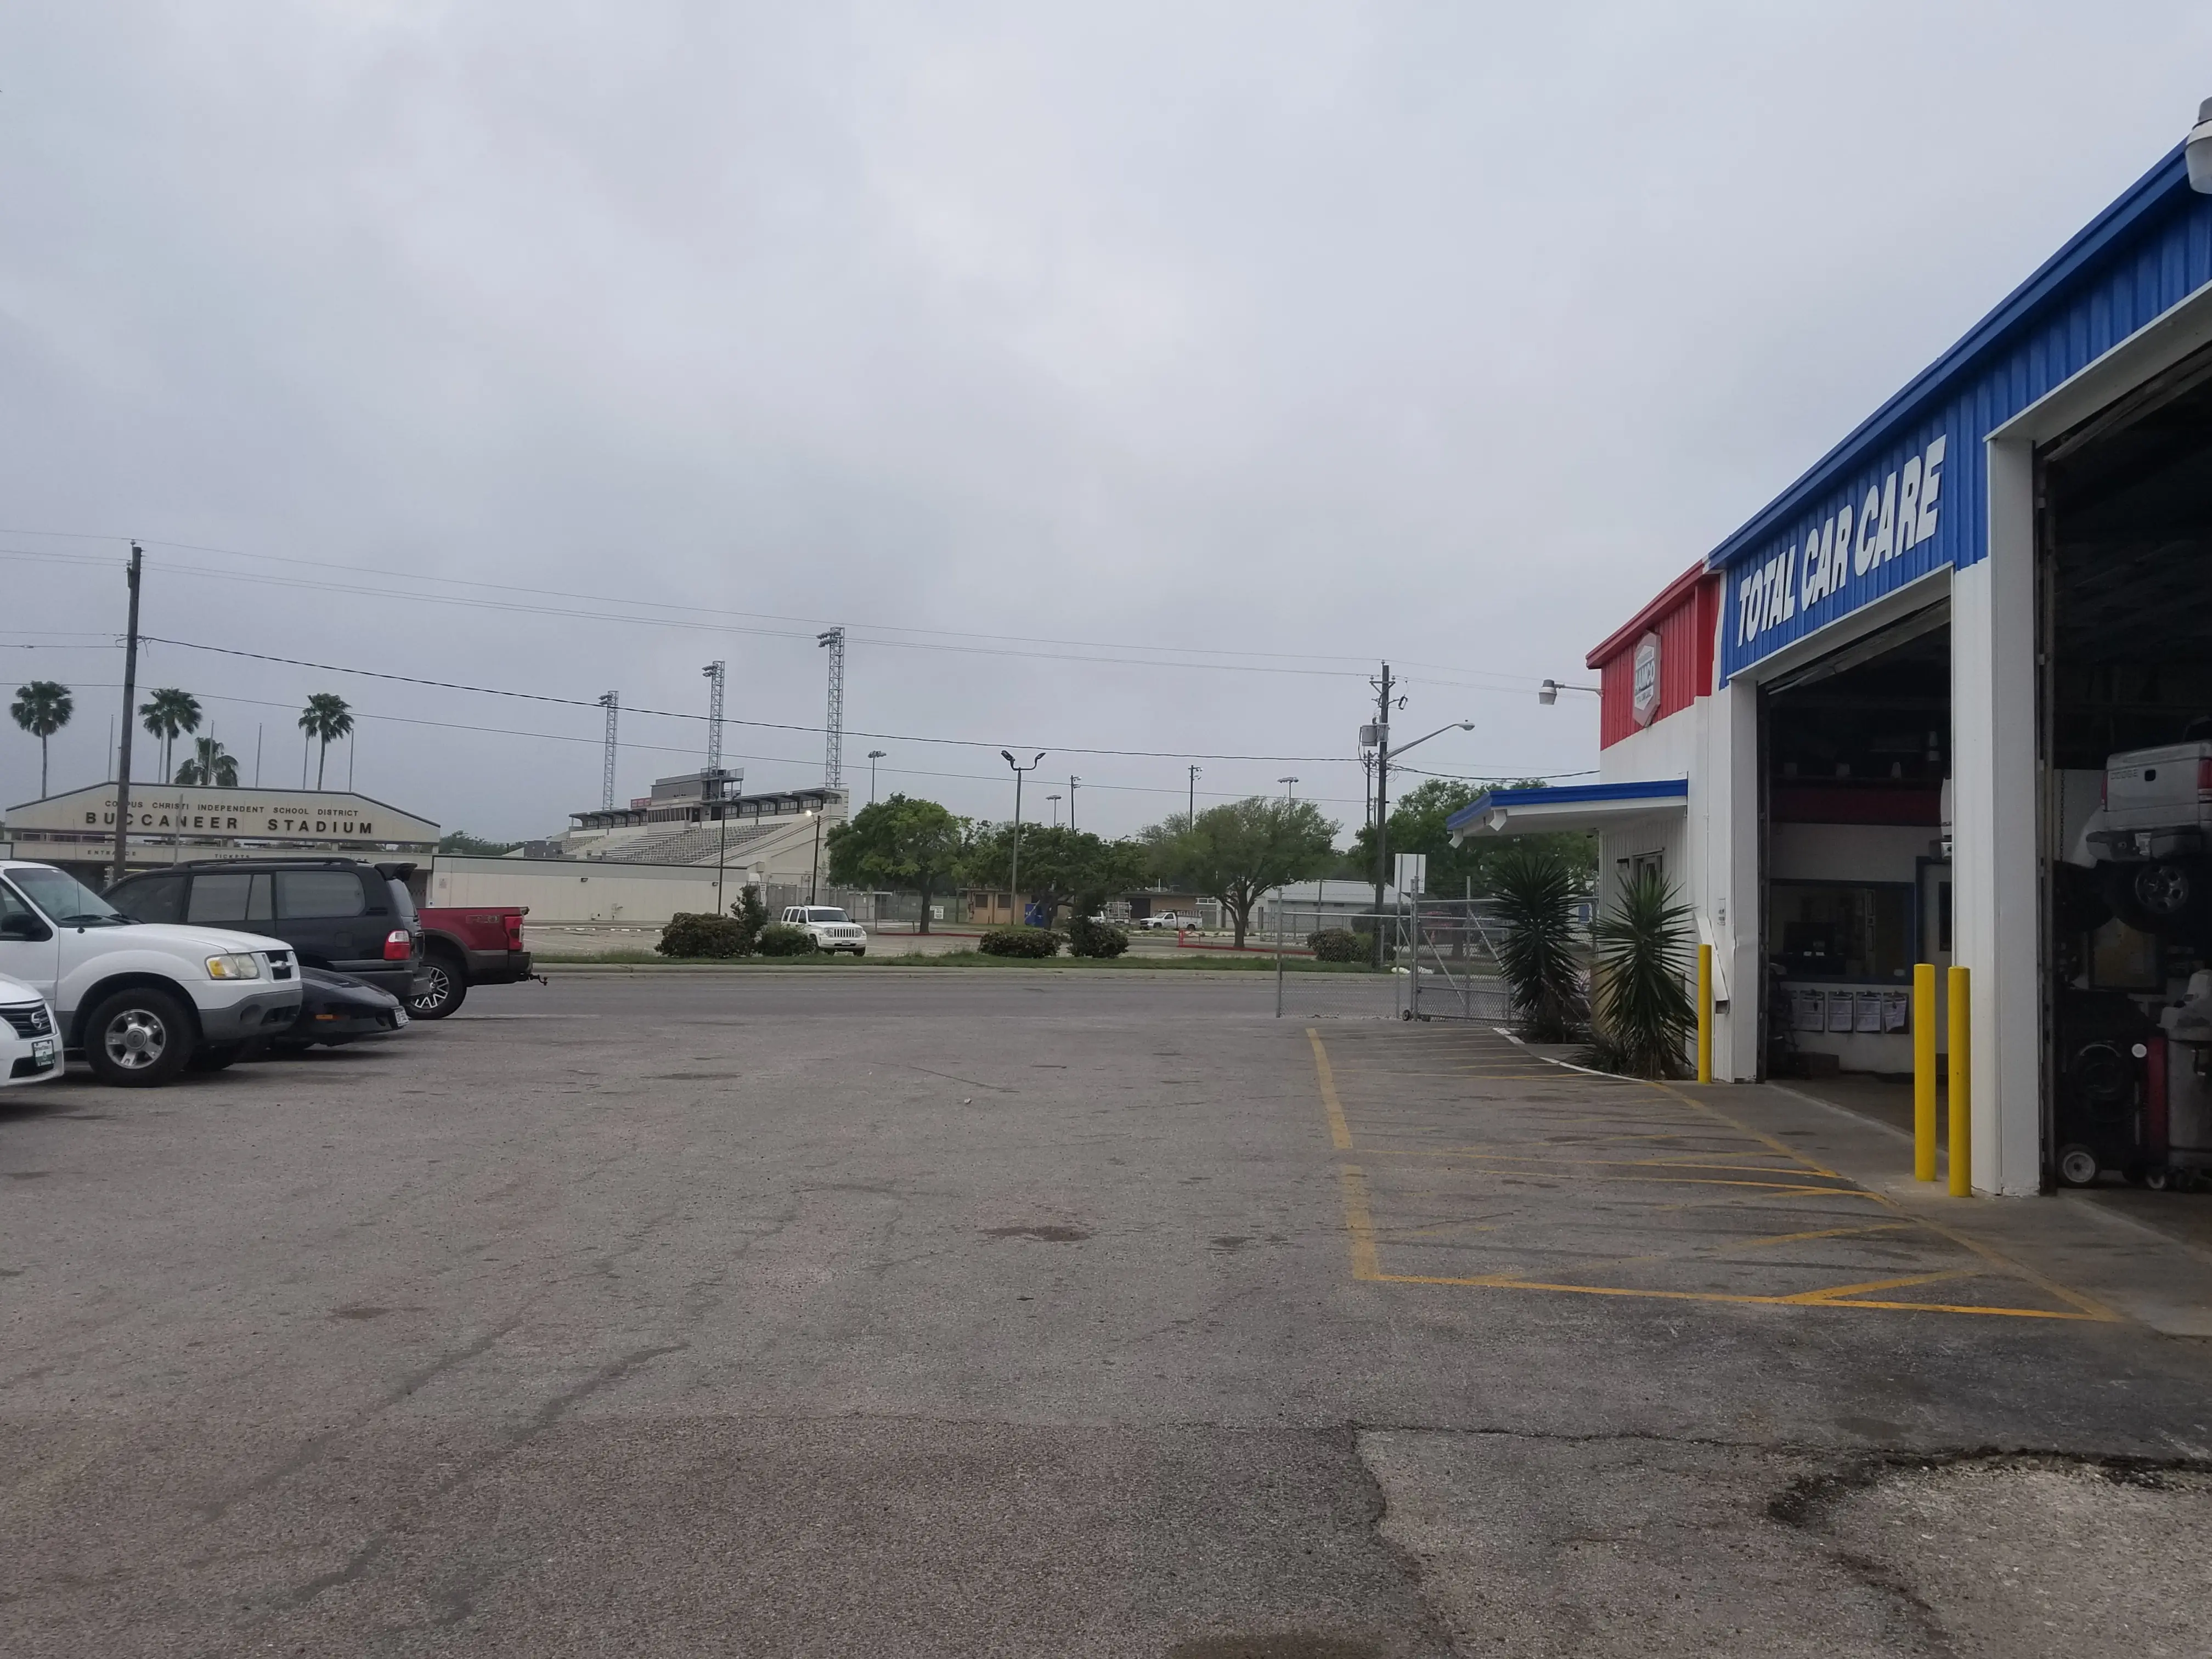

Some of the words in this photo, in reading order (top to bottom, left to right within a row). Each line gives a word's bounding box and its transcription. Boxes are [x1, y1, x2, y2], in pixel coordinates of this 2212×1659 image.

[1737, 546, 1797, 647] TOTAL
[1801, 504, 1853, 612] CAR
[1855, 434, 1946, 577] CARE
[198, 804, 264, 813] INDEPENDENT
[86, 812, 237, 829] BUCCANEER
[268, 819, 372, 834] STADIUM
